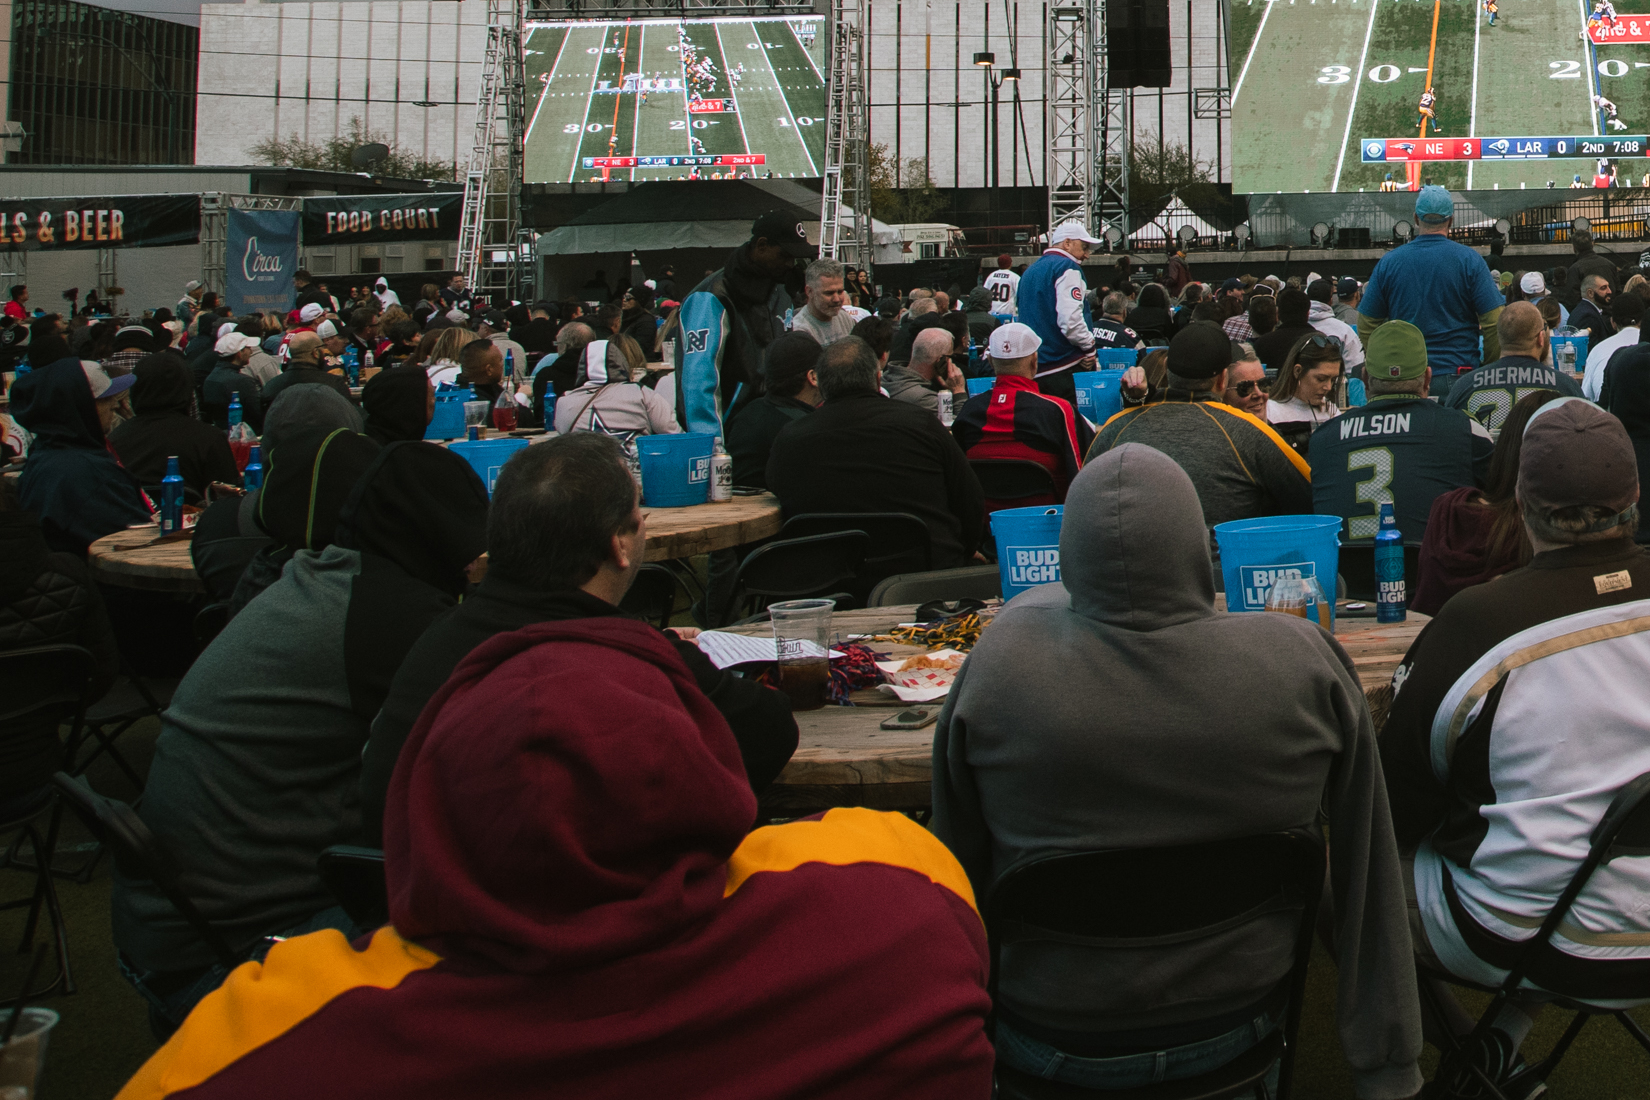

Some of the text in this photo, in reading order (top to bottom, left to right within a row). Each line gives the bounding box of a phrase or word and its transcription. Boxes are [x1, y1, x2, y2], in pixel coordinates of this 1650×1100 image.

[1629, 21, 1643, 36] &
[1317, 64, 1403, 85] 30
[1549, 59, 1629, 79] 20
[1425, 143, 1444, 155] NE
[1462, 142, 1473, 155] 3
[1516, 142, 1543, 153] LAR
[1556, 141, 1567, 154] 0
[1581, 141, 1605, 153] 2ND
[1613, 140, 1640, 153] 7:08
[38, 210, 55, 243] &
[65, 209, 124, 242] BEER
[326, 207, 440, 234] FOOD COURT
[243, 236, 283, 281] Circa
[990, 282, 1011, 302] 40
[1092, 327, 1117, 342] USCHI
[1473, 366, 1557, 388] SHERMAN
[1340, 413, 1411, 440] WILSON
[696, 458, 710, 470] BU
[691, 469, 710, 481] LIG
[1347, 446, 1395, 540] 3
[1016, 550, 1060, 566] BUD
[1380, 580, 1406, 592] BUD
